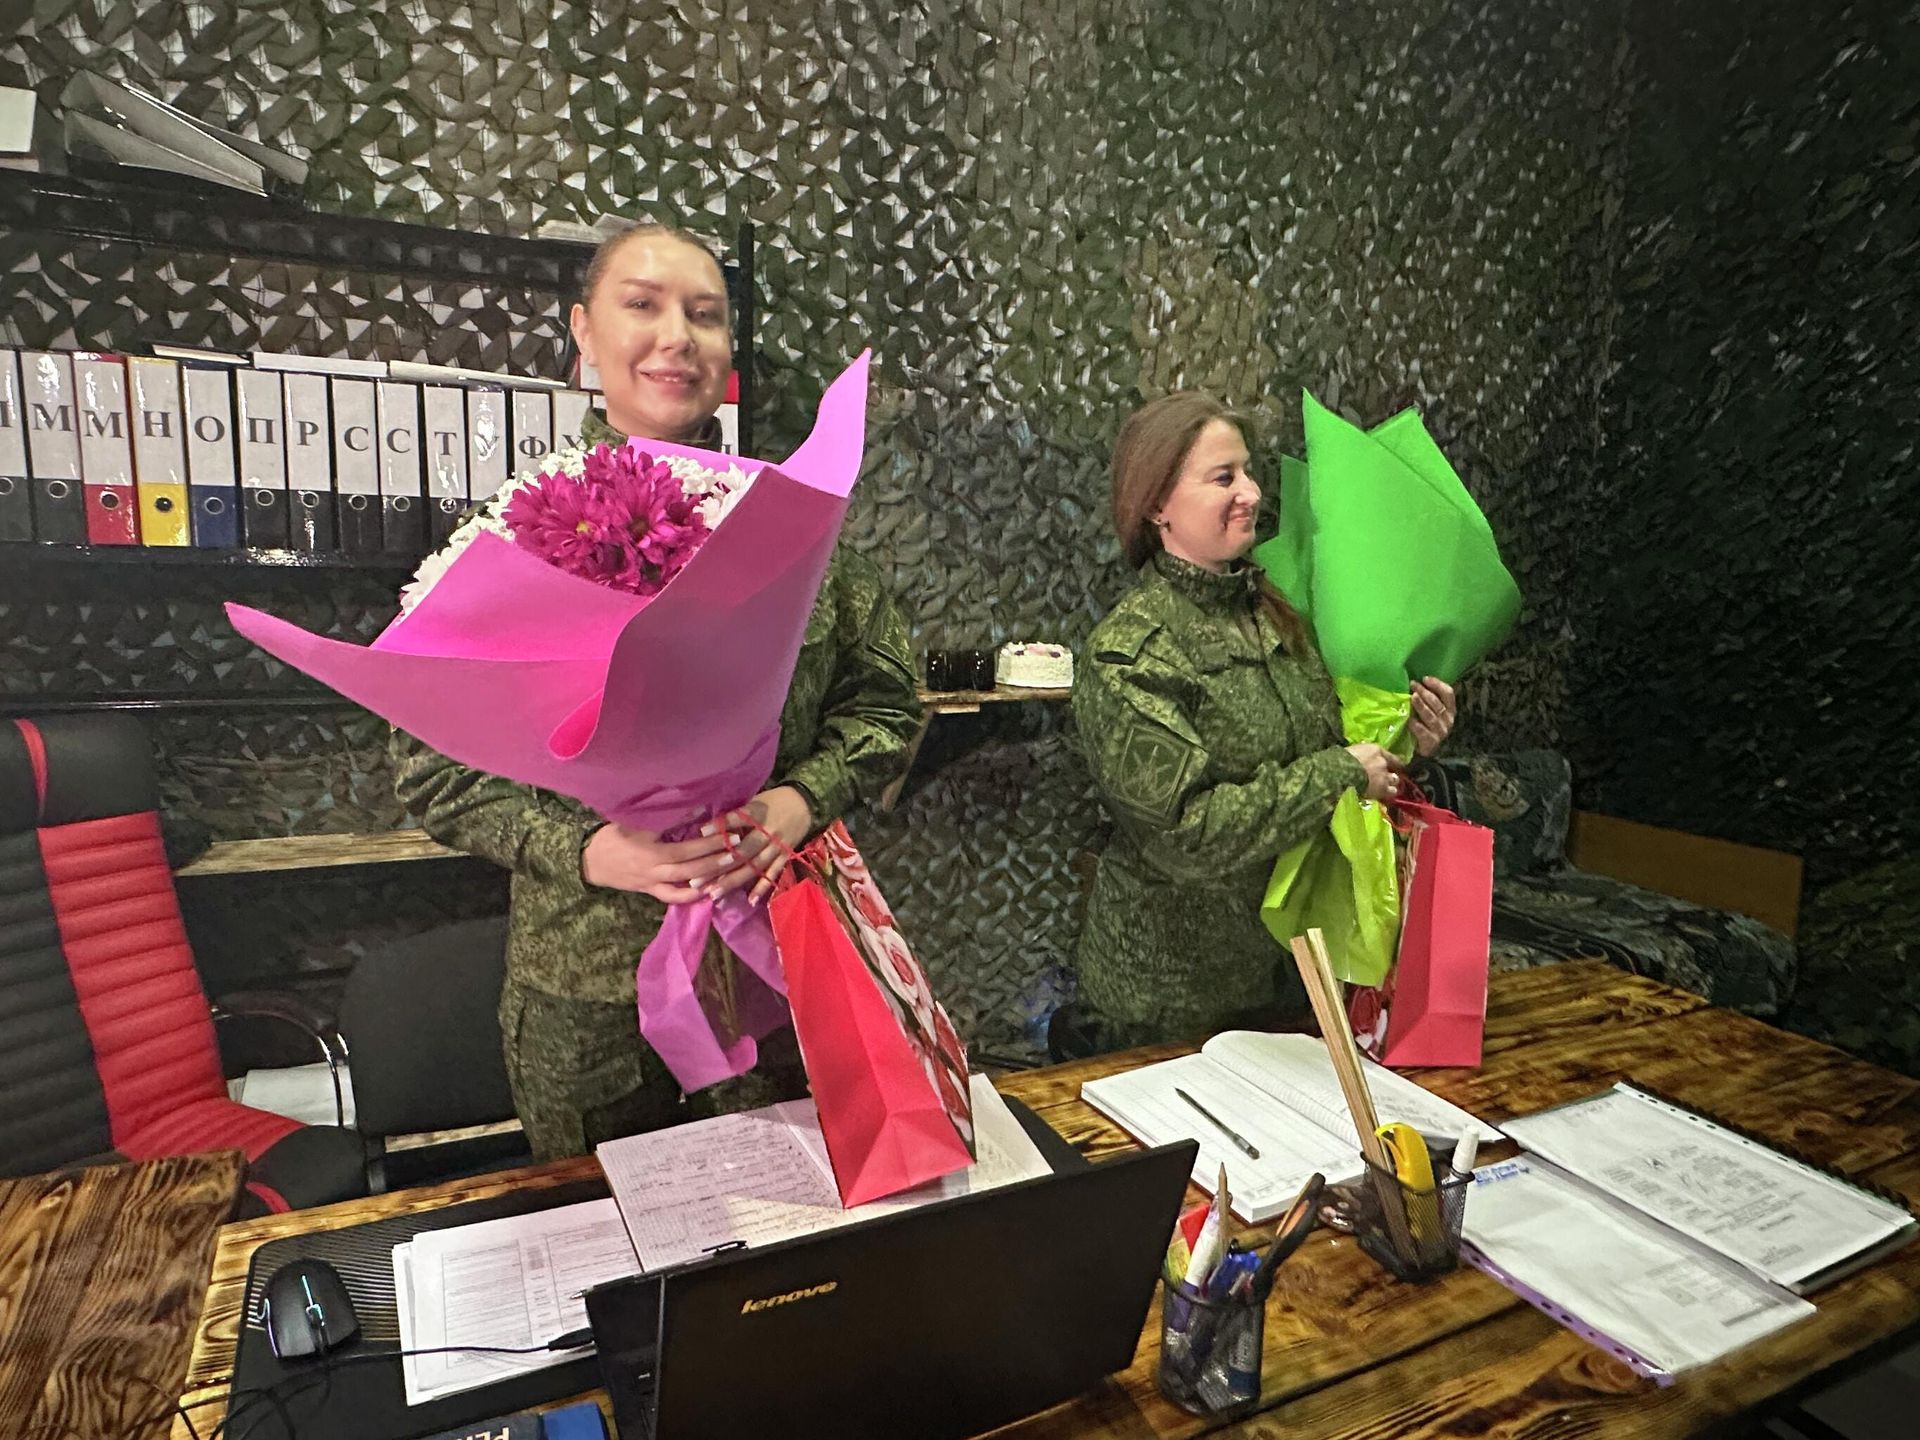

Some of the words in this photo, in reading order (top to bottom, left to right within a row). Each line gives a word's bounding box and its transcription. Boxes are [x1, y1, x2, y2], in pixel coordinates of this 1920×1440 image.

[31, 403, 74, 432] М
[82, 409, 123, 438] М
[143, 410, 174, 439] Н
[194, 415, 226, 443] О
[248, 417, 277, 444] П
[296, 420, 320, 446] Р
[343, 426, 370, 451] С
[386, 428, 412, 453] С
[434, 431, 458, 456] Т
[519, 436, 546, 459] Ф
